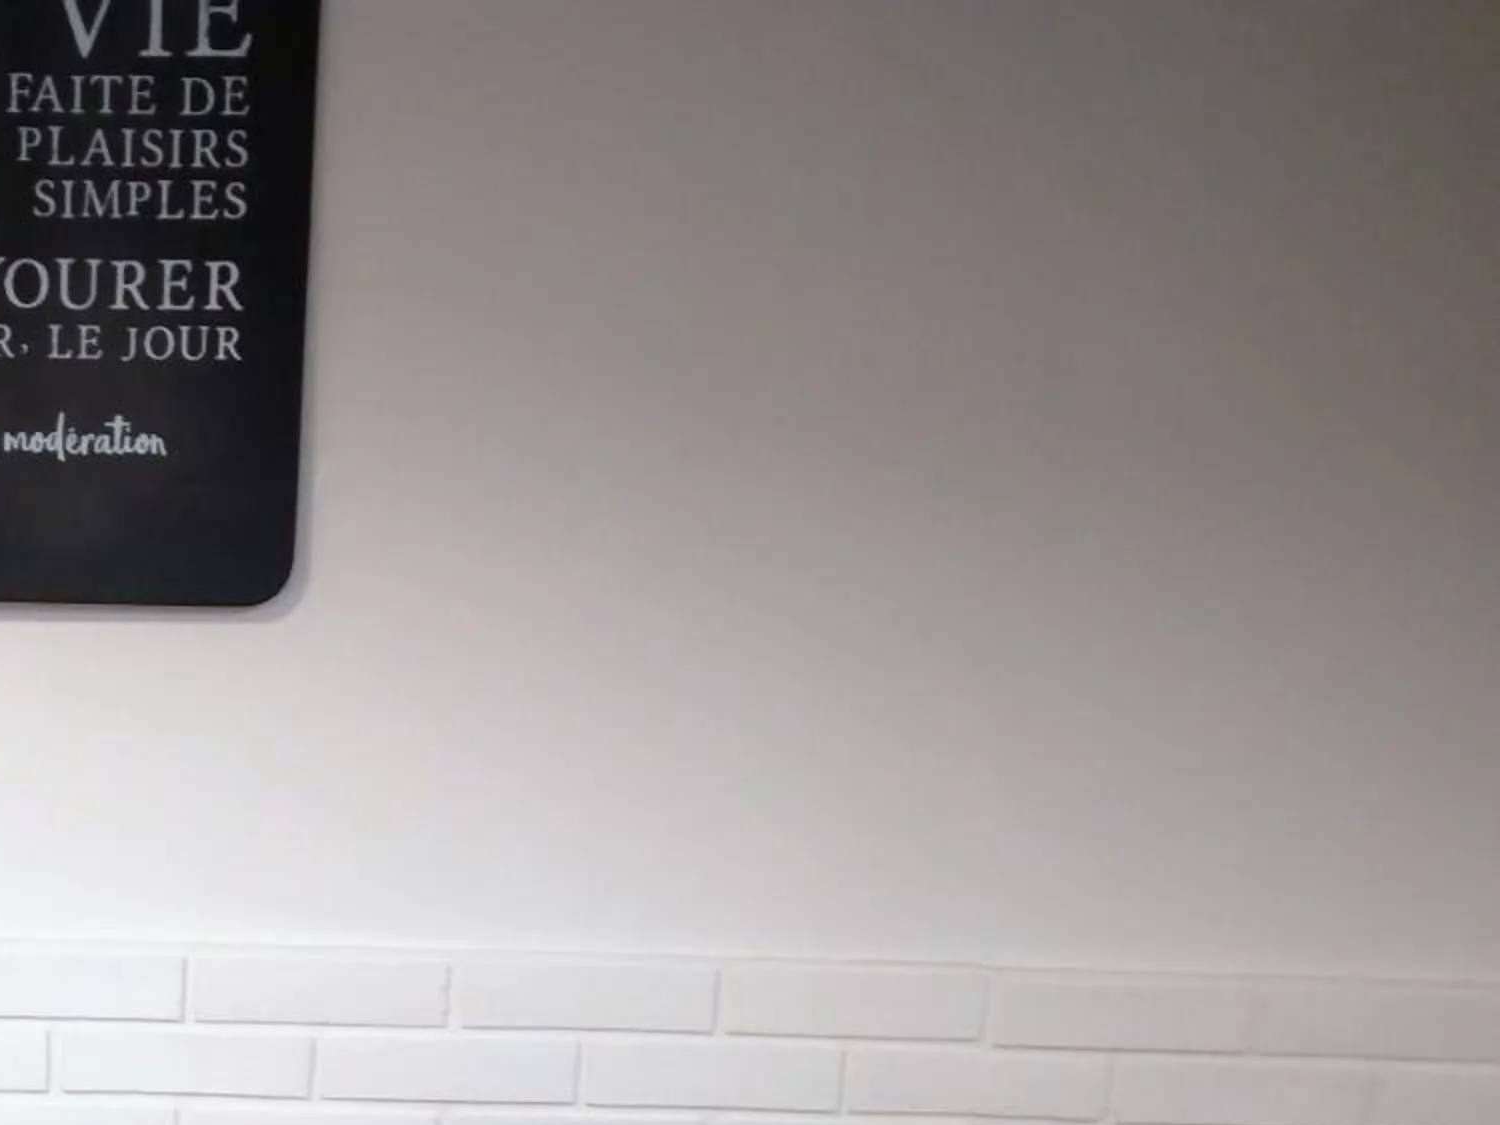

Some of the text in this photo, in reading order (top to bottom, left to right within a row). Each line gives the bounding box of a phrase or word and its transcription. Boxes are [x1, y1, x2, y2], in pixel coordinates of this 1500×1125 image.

[8, 72, 154, 115] FAITE
[181, 76, 247, 116] DE
[18, 125, 248, 169] PLAISIRS
[33, 178, 247, 220] SIMPLES
[47, 323, 103, 361] LE
[120, 324, 242, 363] JOUR
[2, 410, 168, 463] modération
